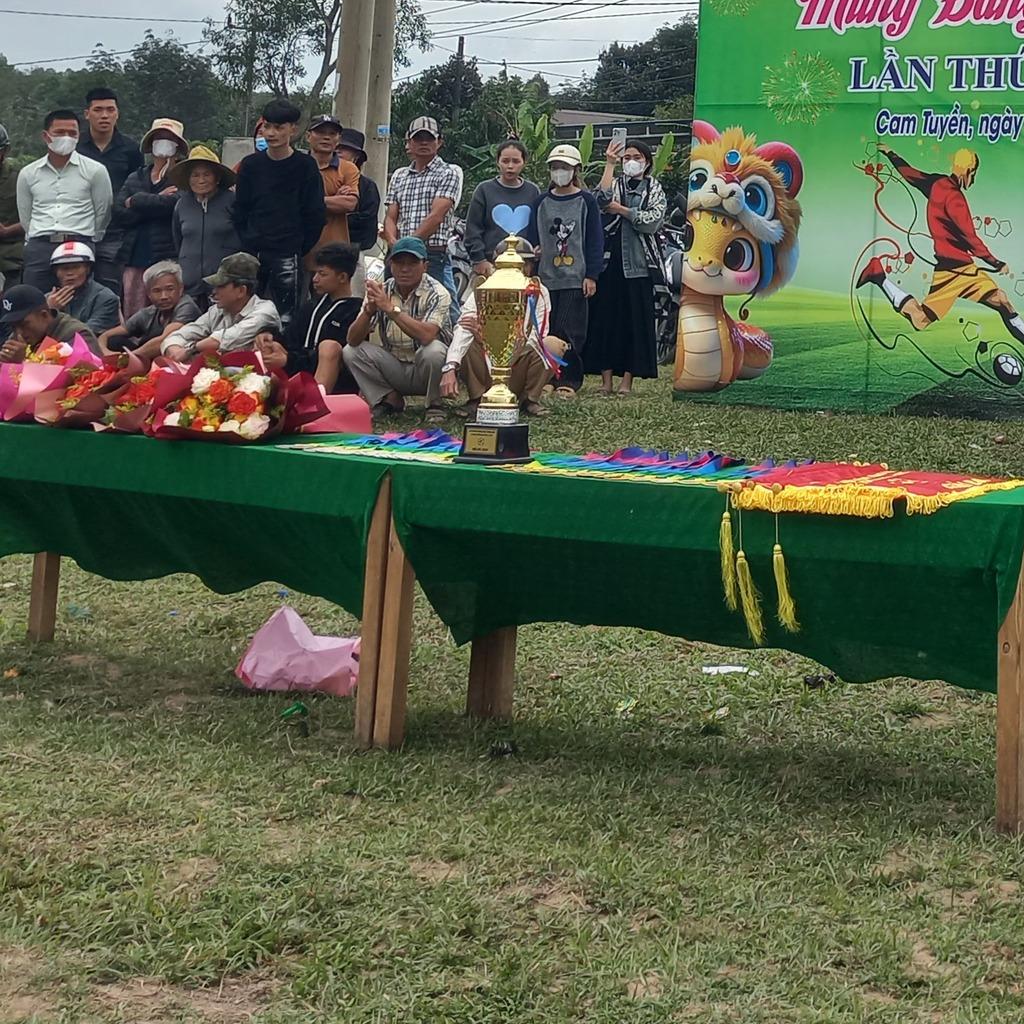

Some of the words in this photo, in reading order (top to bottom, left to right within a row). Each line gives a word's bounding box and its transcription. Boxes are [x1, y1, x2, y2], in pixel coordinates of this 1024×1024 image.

[848, 47, 936, 91] LẦN
[876, 109, 917, 136] Cam
[922, 103, 973, 139] Tuyền,
[979, 111, 1023, 143] ngày
